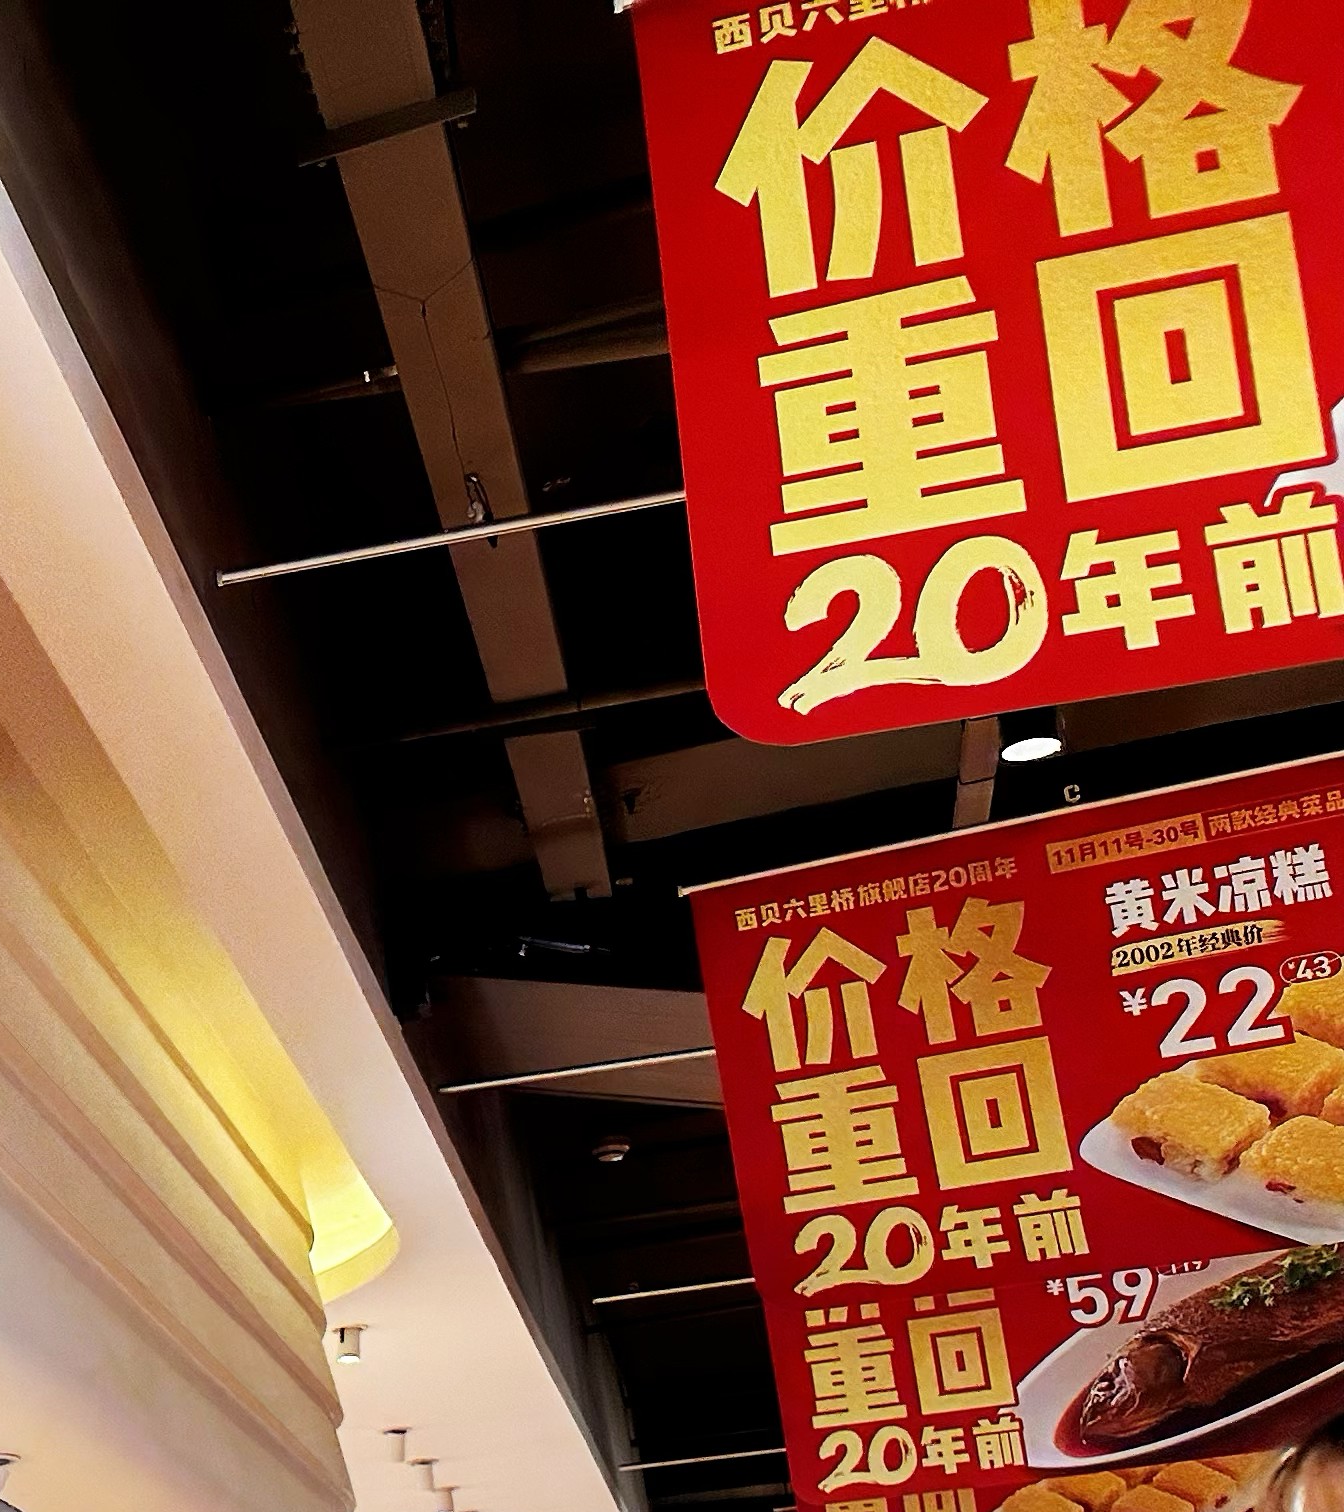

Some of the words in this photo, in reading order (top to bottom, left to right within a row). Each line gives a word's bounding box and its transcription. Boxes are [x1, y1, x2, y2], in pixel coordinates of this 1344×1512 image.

[712, 0, 929, 54] 西贝六里
[715, 0, 1305, 298] 价格
[758, 211, 1328, 556] 重回
[777, 490, 1344, 716] 20年前
[735, 857, 1018, 931] 西贝六里桥旗舰店20周年
[1052, 819, 1201, 867] 11月11号-30号
[1105, 843, 1333, 938] 黄米凉糕
[742, 896, 1052, 1072] 价格
[1115, 924, 1263, 968] 2002年经典价
[1120, 966, 1286, 1059] ¥22
[771, 1036, 1075, 1213] 重回
[793, 1188, 1091, 1297] 20年前
[803, 1306, 1016, 1429] 重回
[818, 1415, 1026, 1493] 20年前
